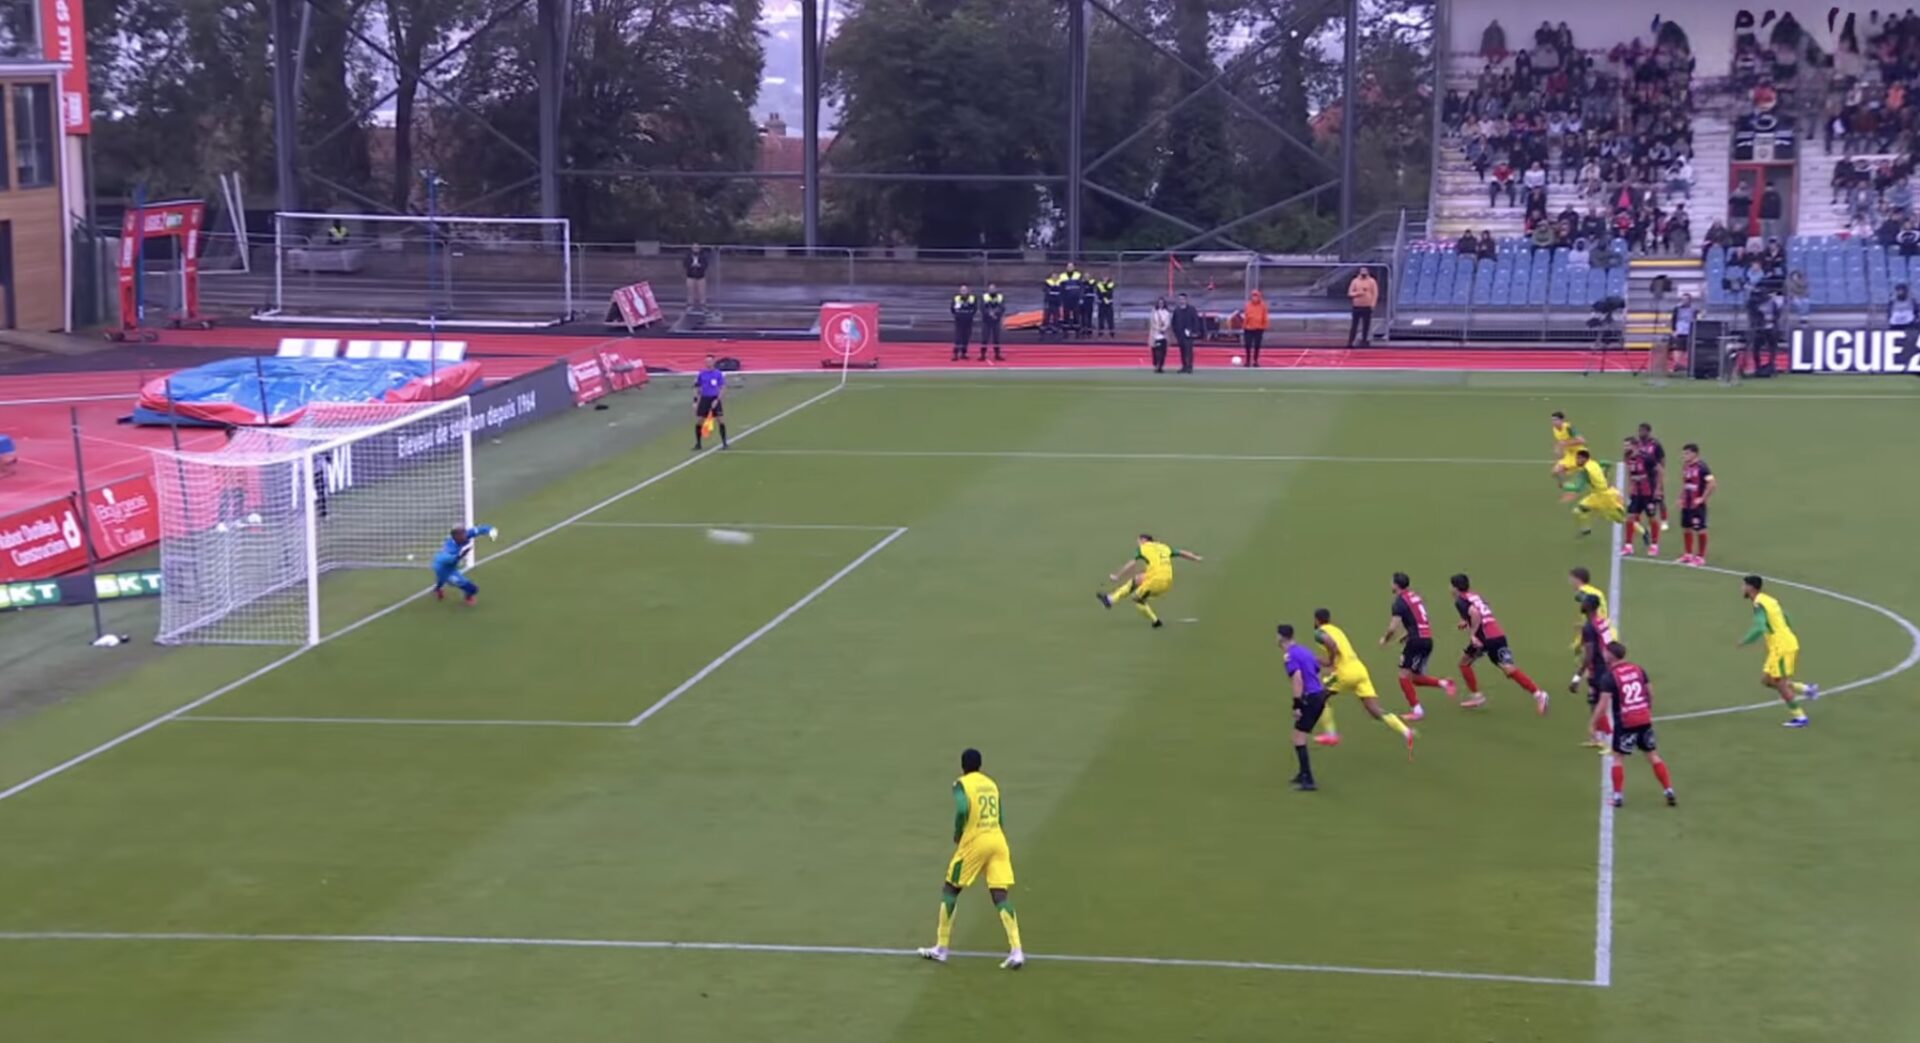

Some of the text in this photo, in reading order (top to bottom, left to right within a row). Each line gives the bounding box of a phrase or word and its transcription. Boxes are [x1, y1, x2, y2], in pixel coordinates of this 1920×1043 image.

[486, 398, 517, 427] depuis
[517, 390, 536, 415] 1964
[95, 573, 162, 598] BKT
[1622, 681, 1645, 704] 22
[978, 795, 997, 819] 28
